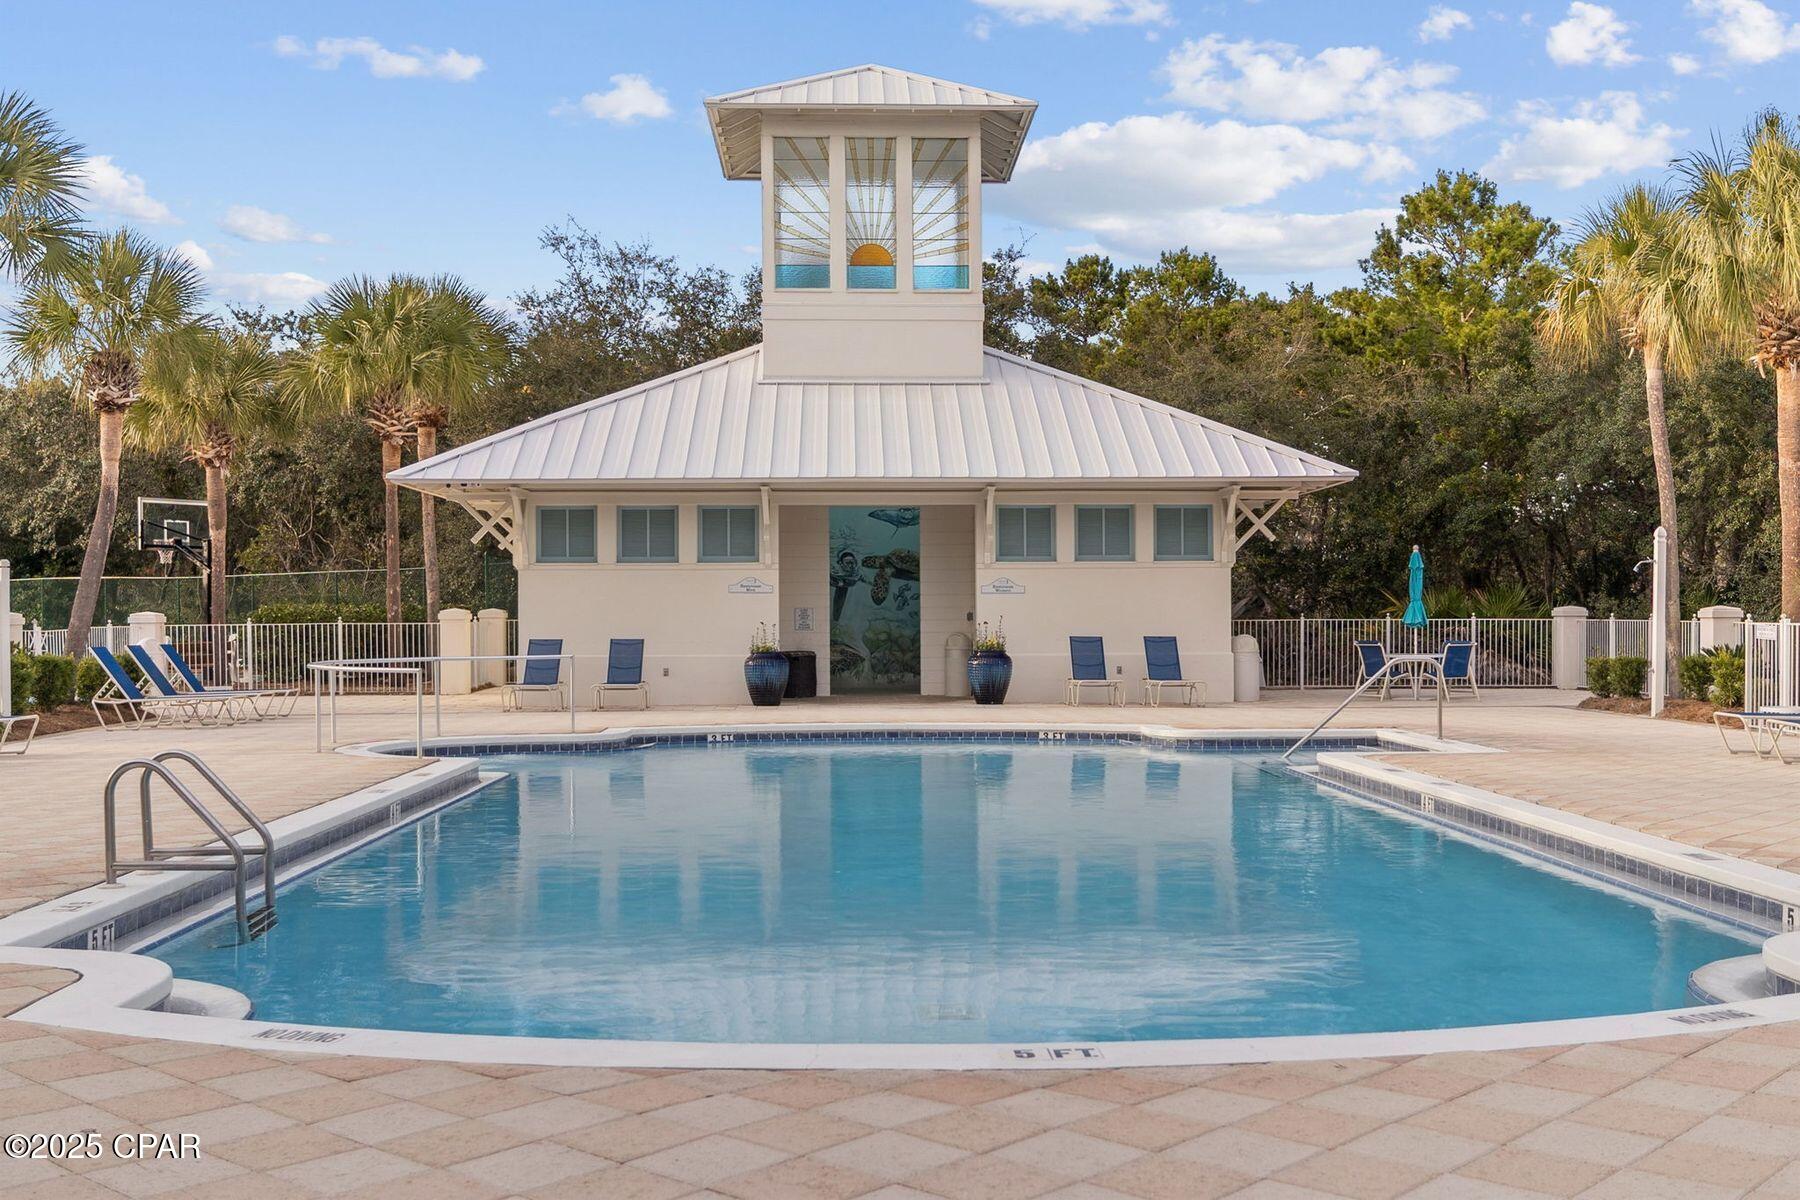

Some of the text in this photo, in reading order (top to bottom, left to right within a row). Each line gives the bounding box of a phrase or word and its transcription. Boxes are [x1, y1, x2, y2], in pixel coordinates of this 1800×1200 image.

[1053, 731, 1064, 739] FT
[1787, 907, 1795, 926] 5
[92, 923, 114, 948] 5 FT
[1013, 1047, 1096, 1059] 5 FT
